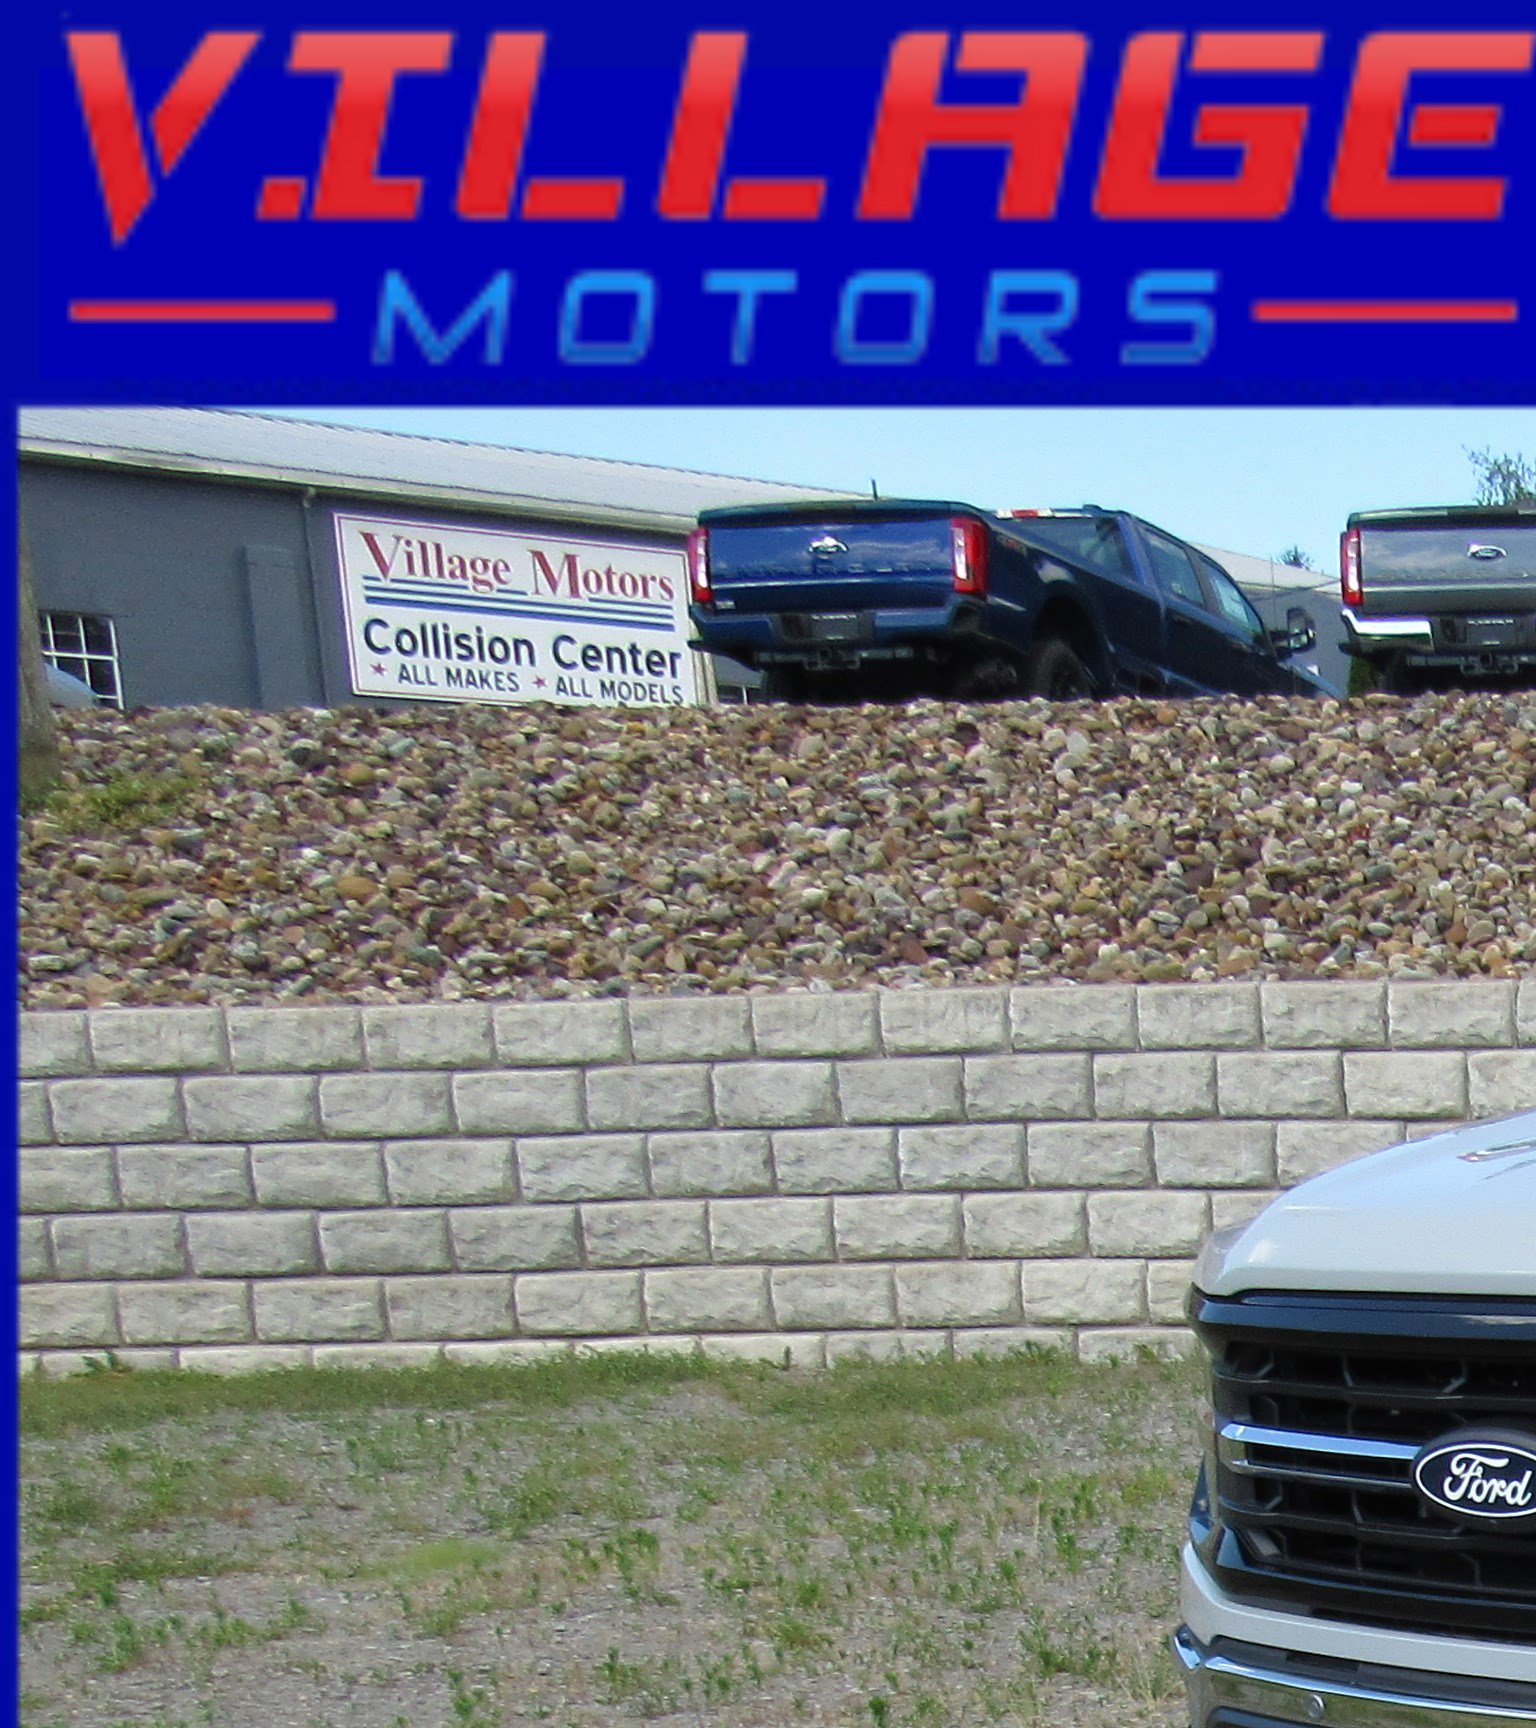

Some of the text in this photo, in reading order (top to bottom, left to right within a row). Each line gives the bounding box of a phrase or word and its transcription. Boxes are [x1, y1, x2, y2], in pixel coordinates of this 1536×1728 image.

[358, 530, 676, 601] Village Motors
[363, 617, 682, 679] Collision Center
[398, 663, 684, 705] ALL MAKES ALL MODELS
[1443, 1452, 1533, 1507] Ford
